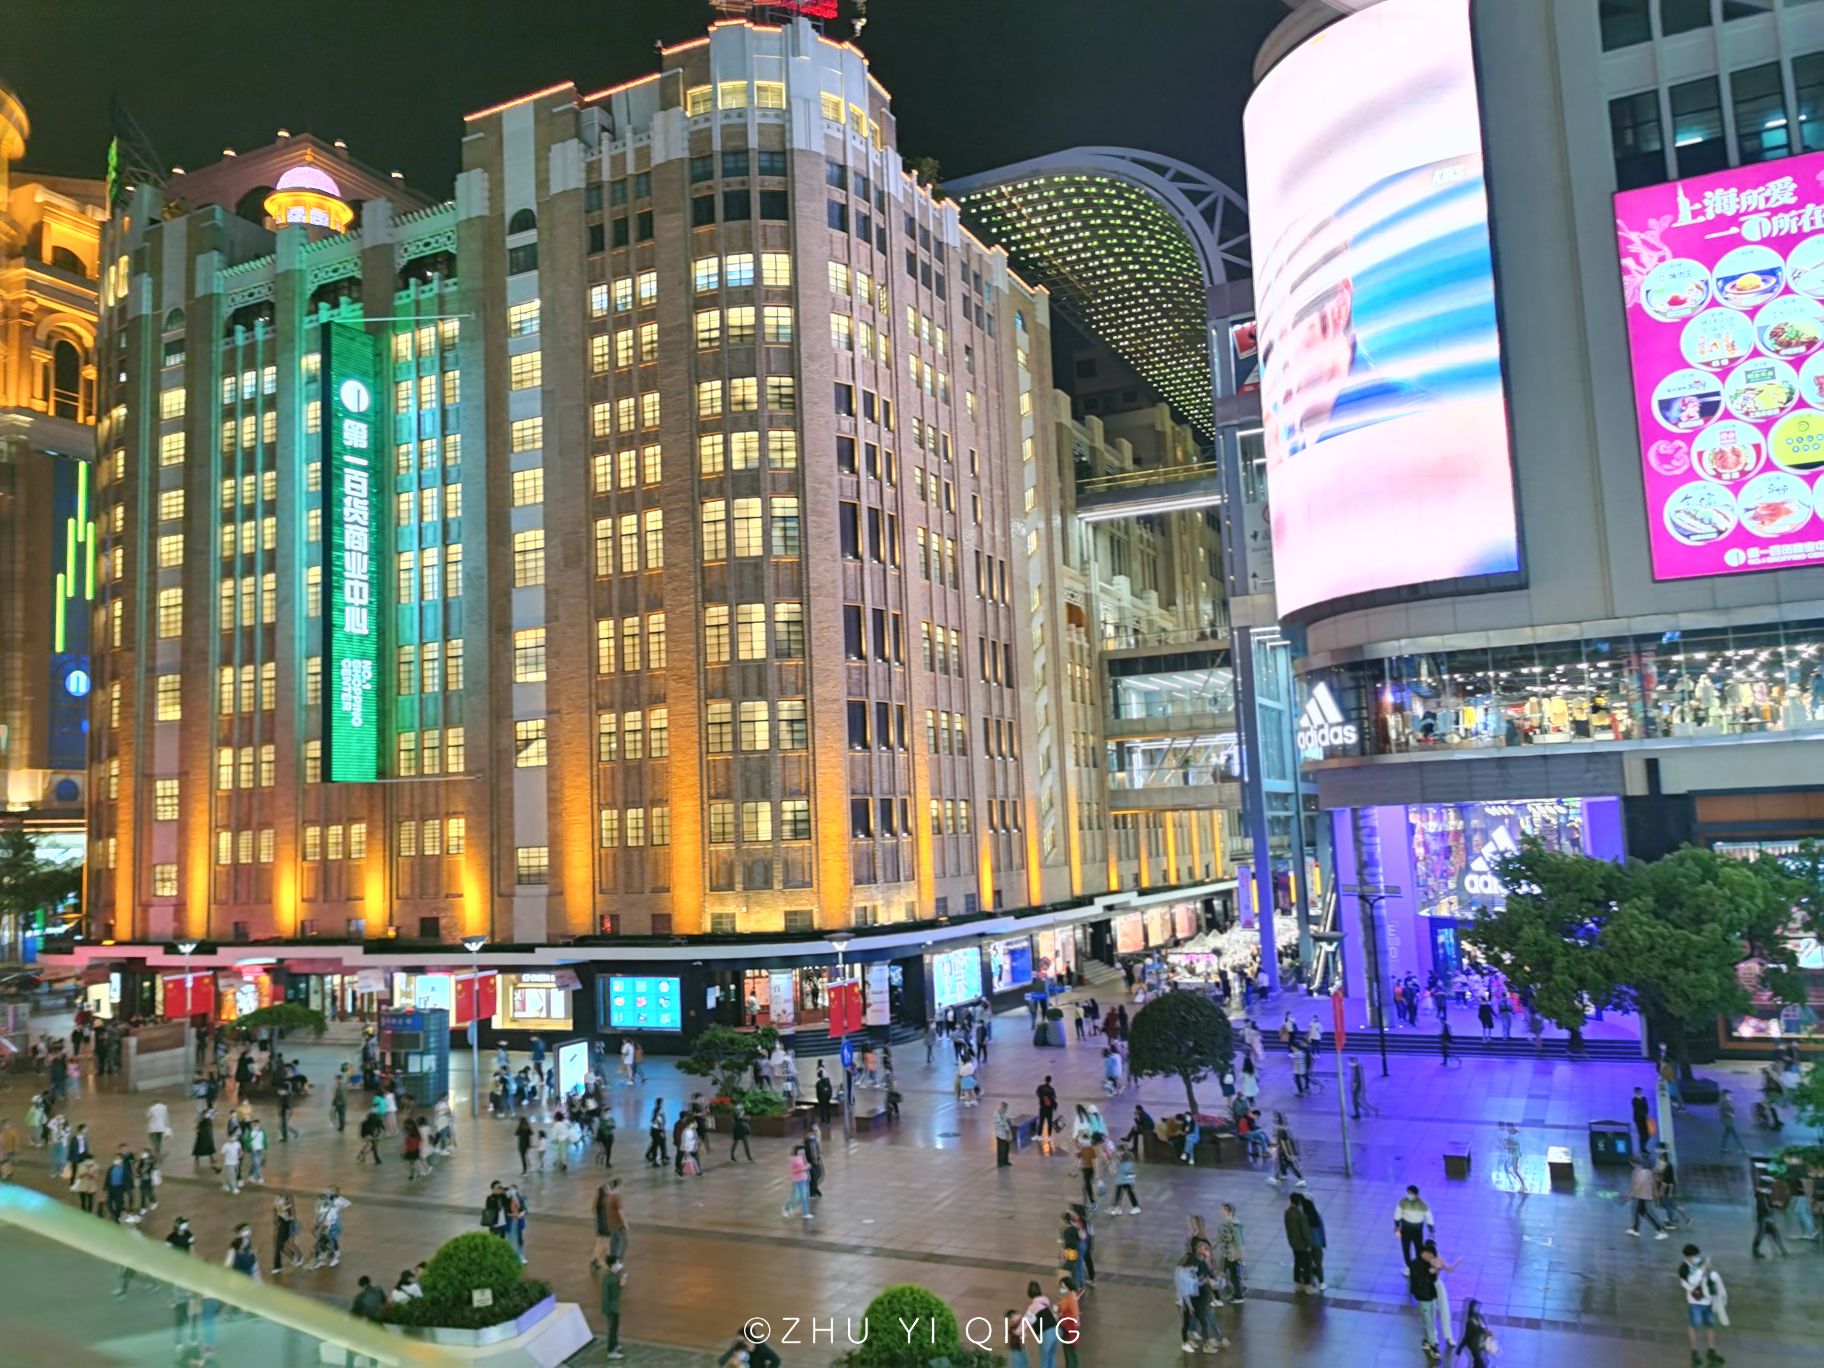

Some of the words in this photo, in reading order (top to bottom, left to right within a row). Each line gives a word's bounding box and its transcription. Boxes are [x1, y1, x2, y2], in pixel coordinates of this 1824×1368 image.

[1671, 176, 1798, 227] 上海所爱
[342, 418, 369, 635] 第一百货商业中心
[341, 658, 352, 712] CENTER
[351, 659, 363, 728] SHOPPING
[361, 659, 373, 690] NO.1
[1297, 722, 1359, 750] adidas
